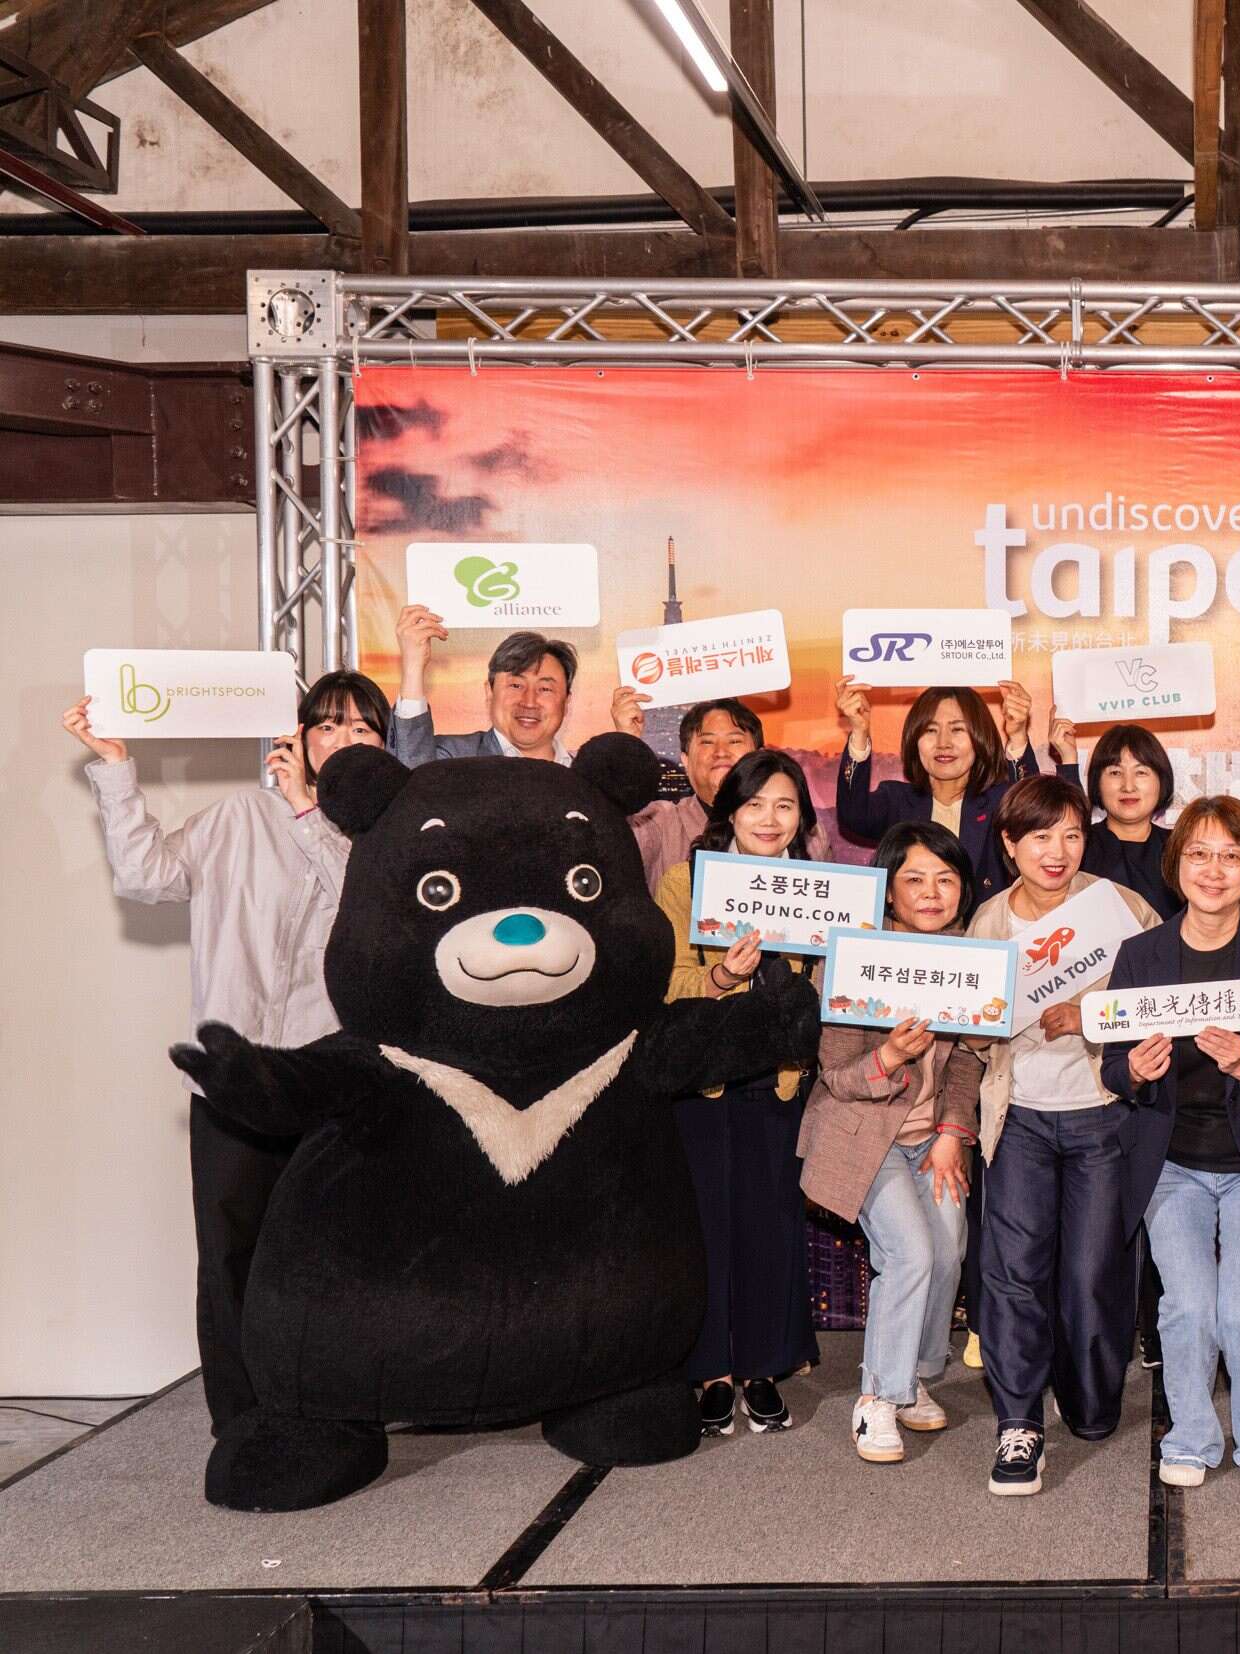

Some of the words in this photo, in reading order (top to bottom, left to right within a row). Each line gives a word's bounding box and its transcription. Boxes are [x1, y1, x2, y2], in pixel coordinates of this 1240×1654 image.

[493, 603, 562, 616] alliance
[665, 643, 717, 657] TRAVEL
[722, 634, 773, 650] ZENITH
[940, 639, 1004, 651] (주)에스알투어
[666, 645, 775, 677] 제니스트래블
[941, 652, 973, 660] SRTOUR
[1098, 698, 1136, 712] VVIP
[1141, 692, 1182, 706] CLUB
[749, 873, 831, 899] 소풍닷컴
[860, 964, 980, 990] 제주섬문화기획
[1027, 976, 1067, 1004] VIVA
[1063, 947, 1107, 980] TOUR
[1098, 1021, 1130, 1031] TAIPEI
